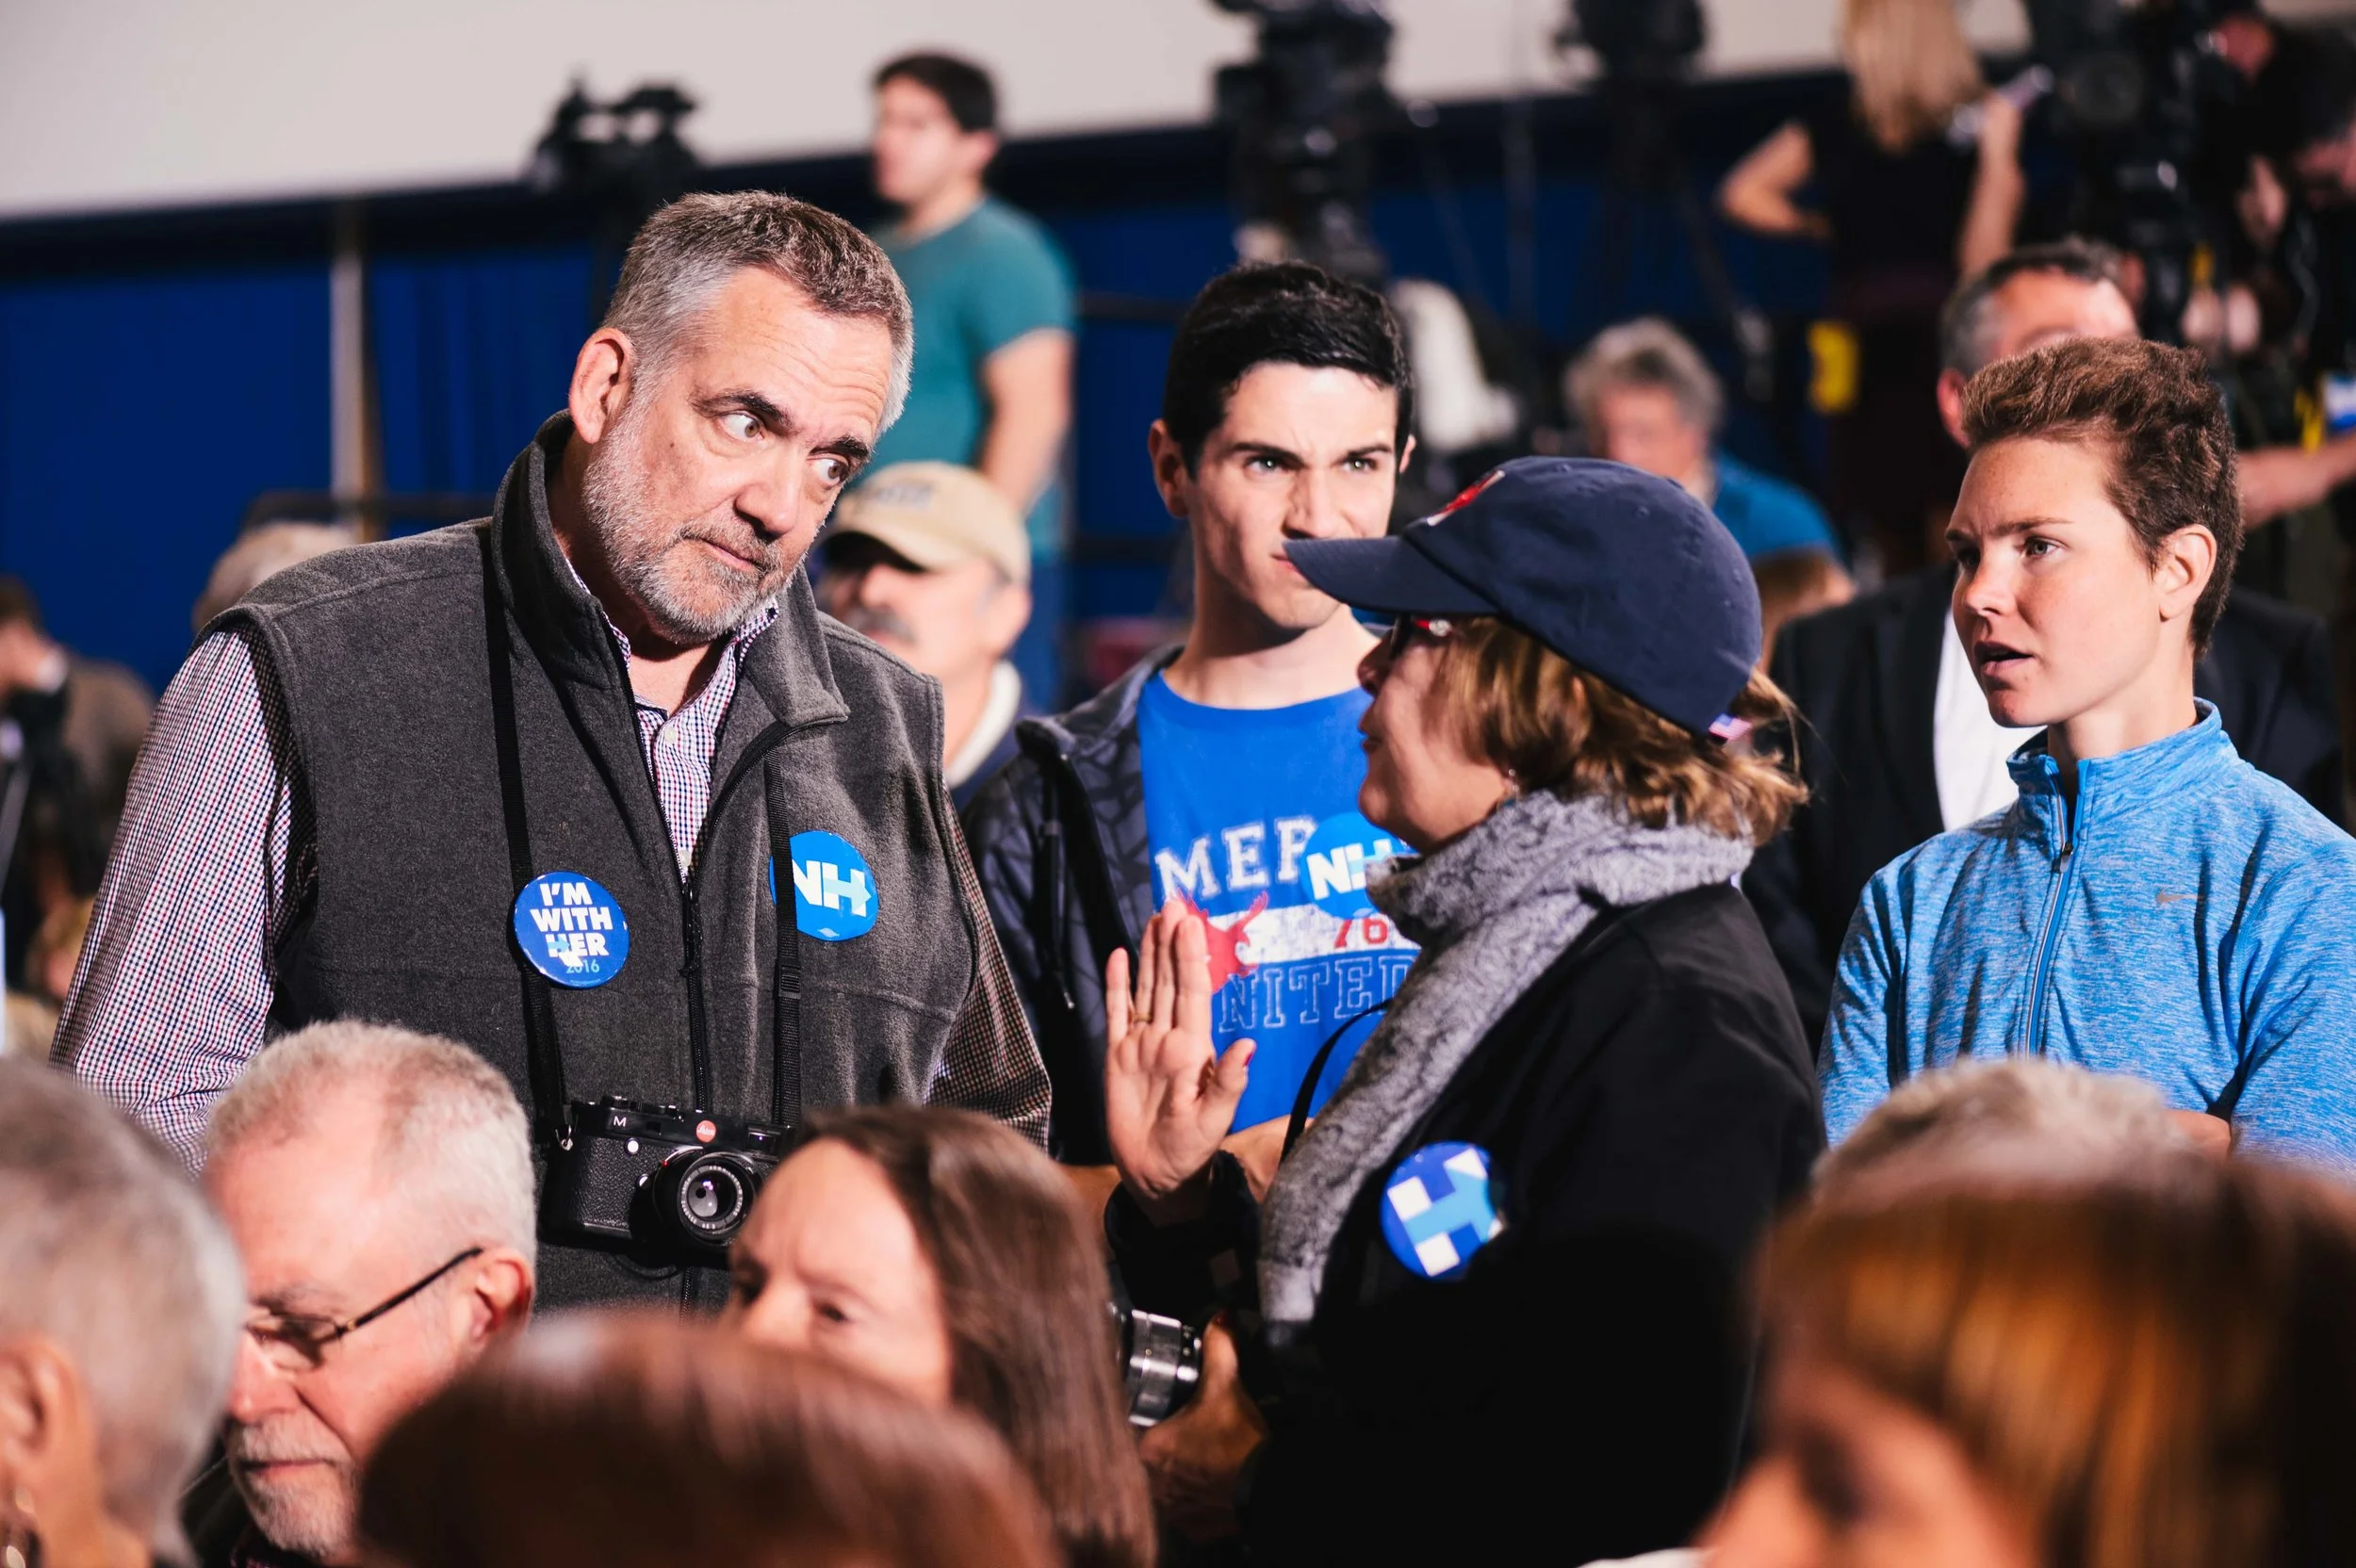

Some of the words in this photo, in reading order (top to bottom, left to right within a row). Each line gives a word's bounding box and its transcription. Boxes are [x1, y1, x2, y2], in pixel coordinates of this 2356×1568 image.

[539, 882, 593, 906] I'M
[792, 859, 872, 918] NH
[530, 906, 614, 932] WITH
[545, 932, 610, 957] HER
[613, 1116, 627, 1127] M
